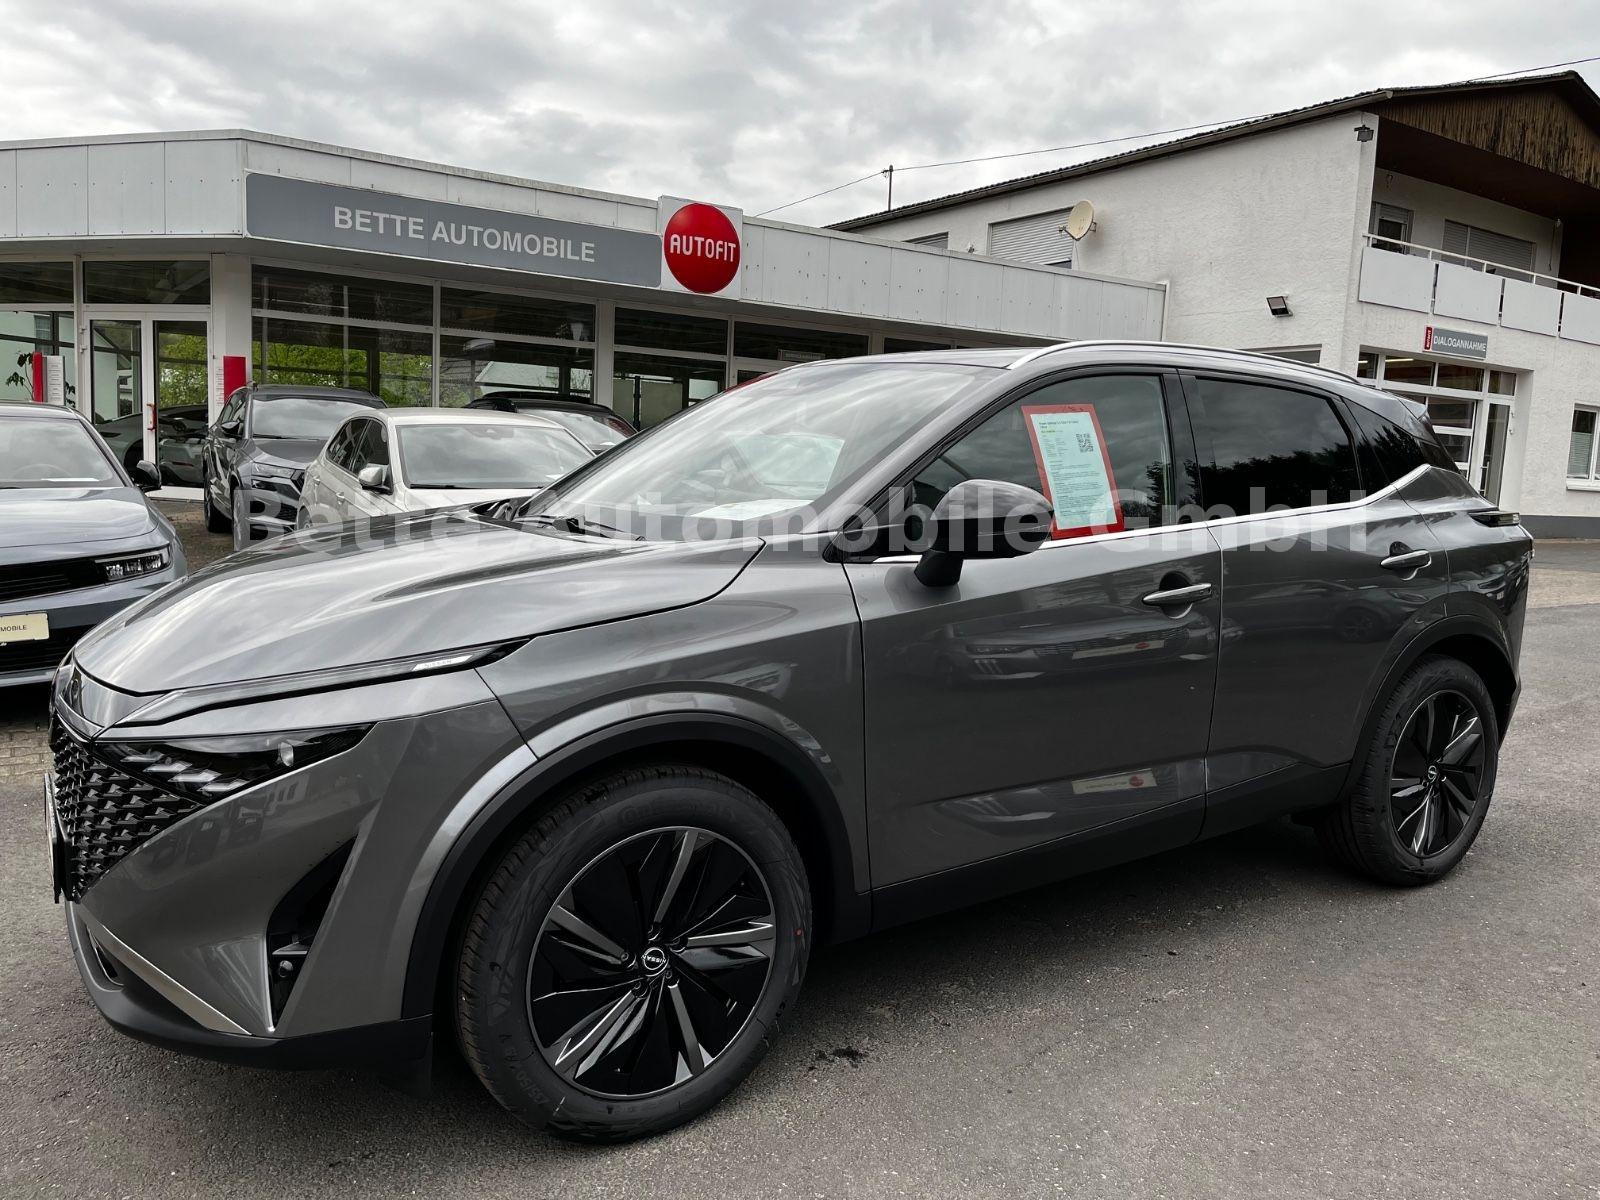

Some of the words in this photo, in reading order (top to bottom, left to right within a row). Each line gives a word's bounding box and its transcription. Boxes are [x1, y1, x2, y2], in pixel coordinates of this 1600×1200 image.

[334, 206, 425, 240] BETTE
[431, 220, 595, 263] AUTOMOBILE
[669, 233, 737, 263] AUTOFIT
[1433, 335, 1487, 352] DIALOGANNAHME
